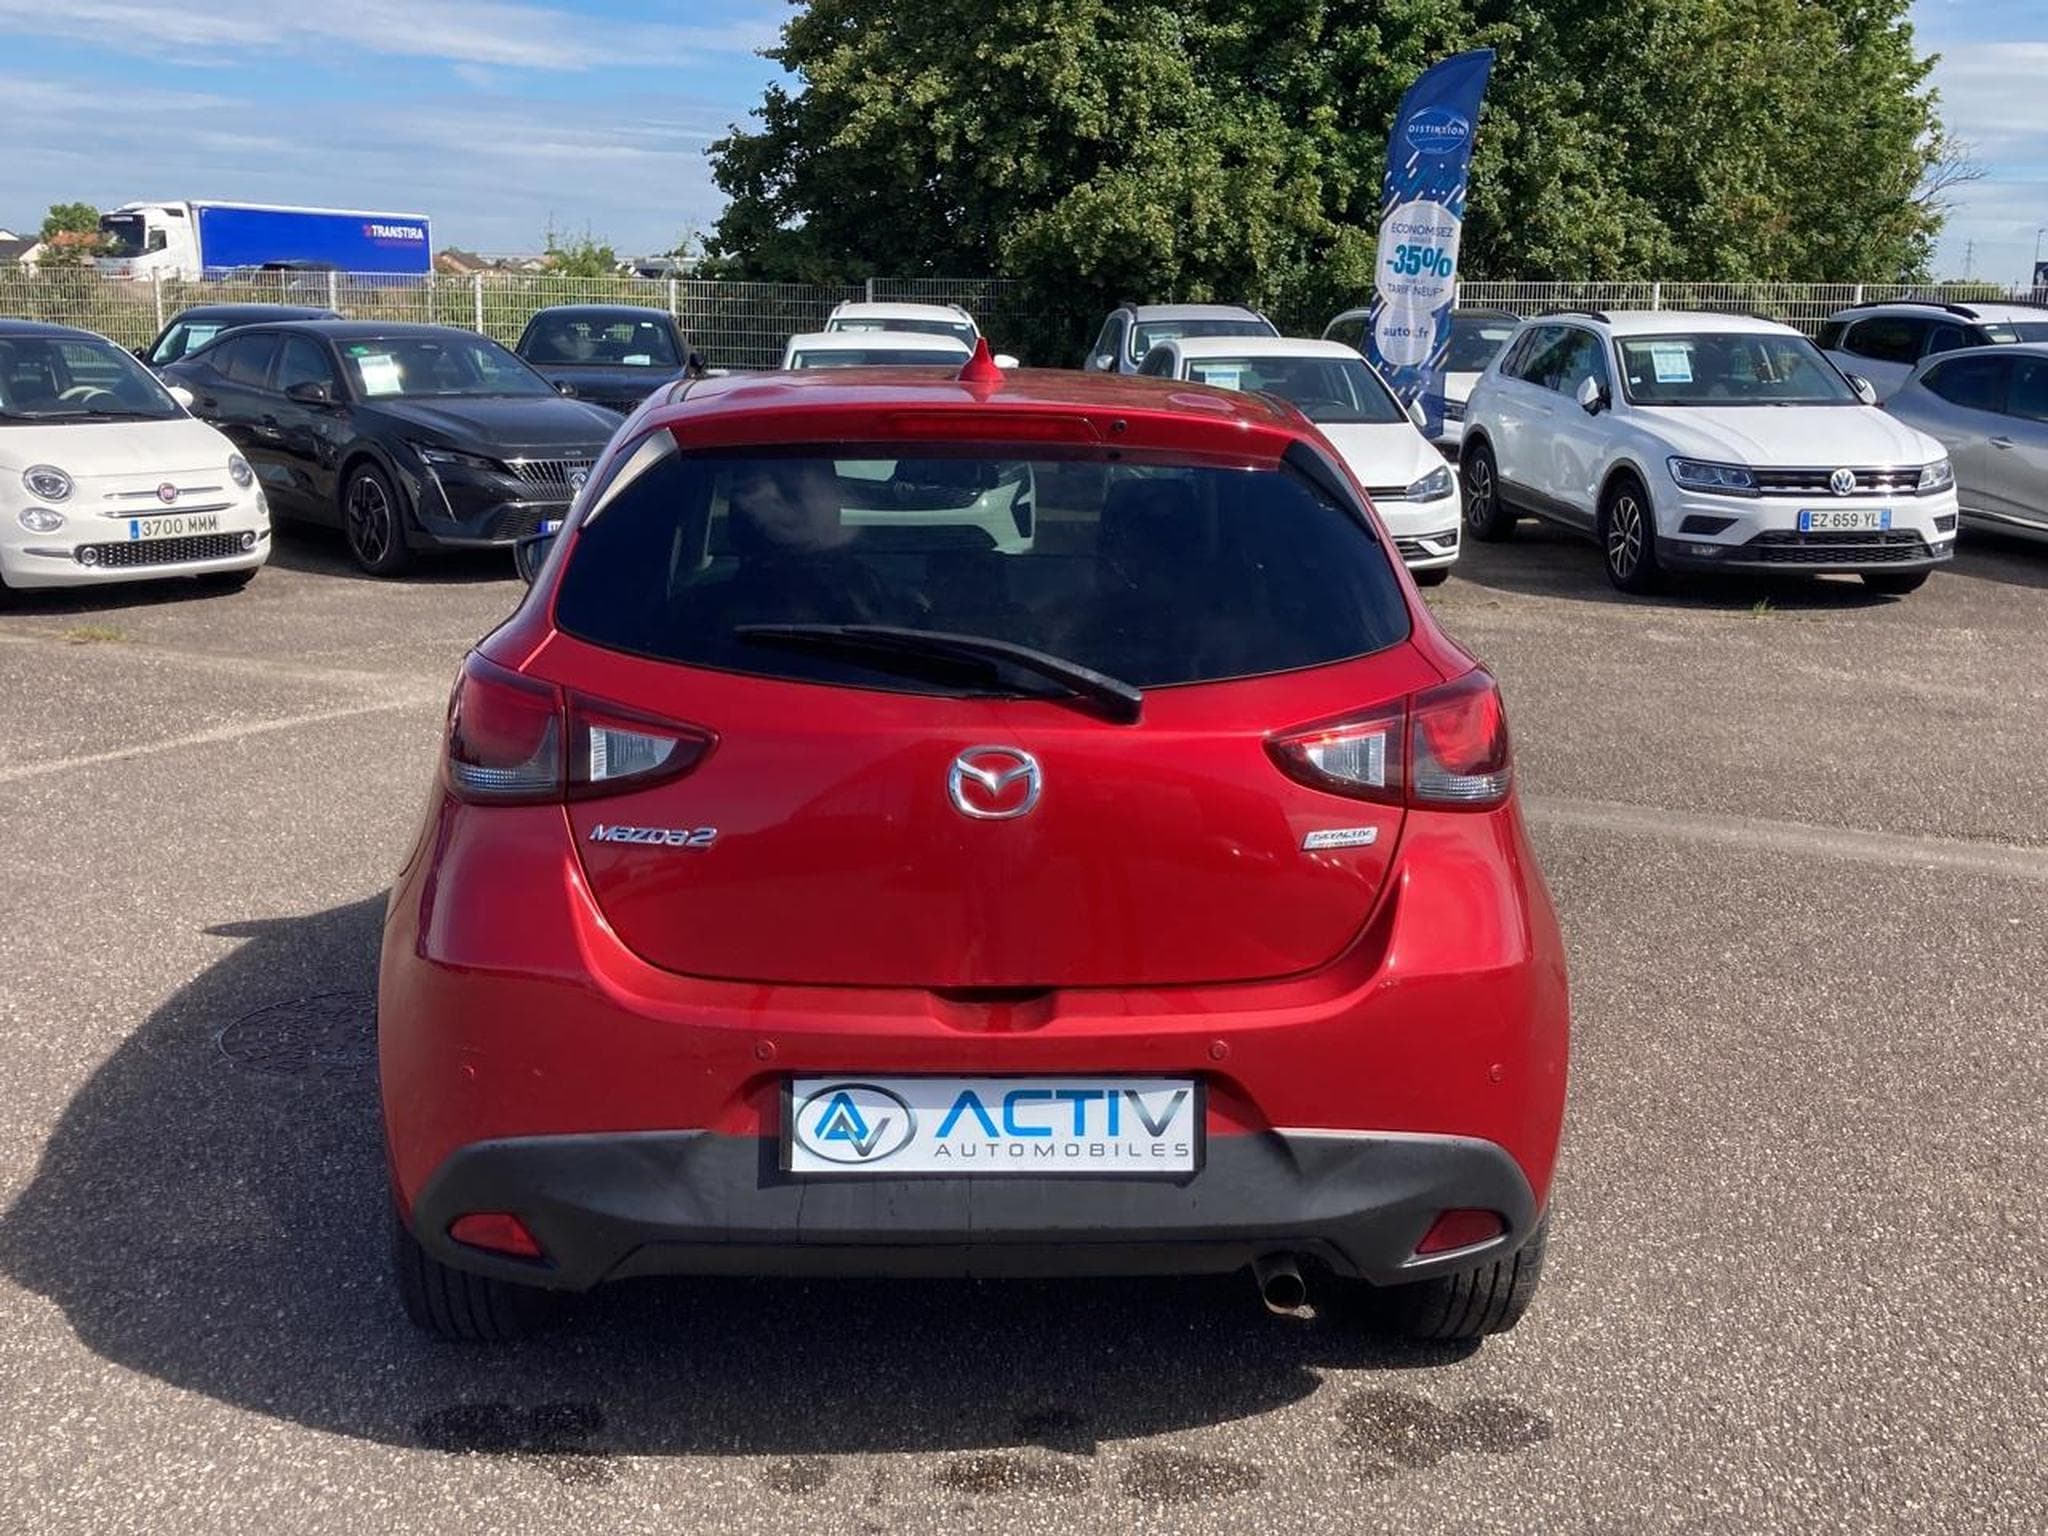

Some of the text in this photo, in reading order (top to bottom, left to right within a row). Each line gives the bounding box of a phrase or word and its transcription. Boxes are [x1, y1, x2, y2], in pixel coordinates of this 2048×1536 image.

[1386, 244, 1453, 278] -35%
[143, 515, 217, 537] 3700 MMM
[934, 1089, 1189, 1138] ACTIV
[934, 1142, 1190, 1158] AUTOMOBILES
